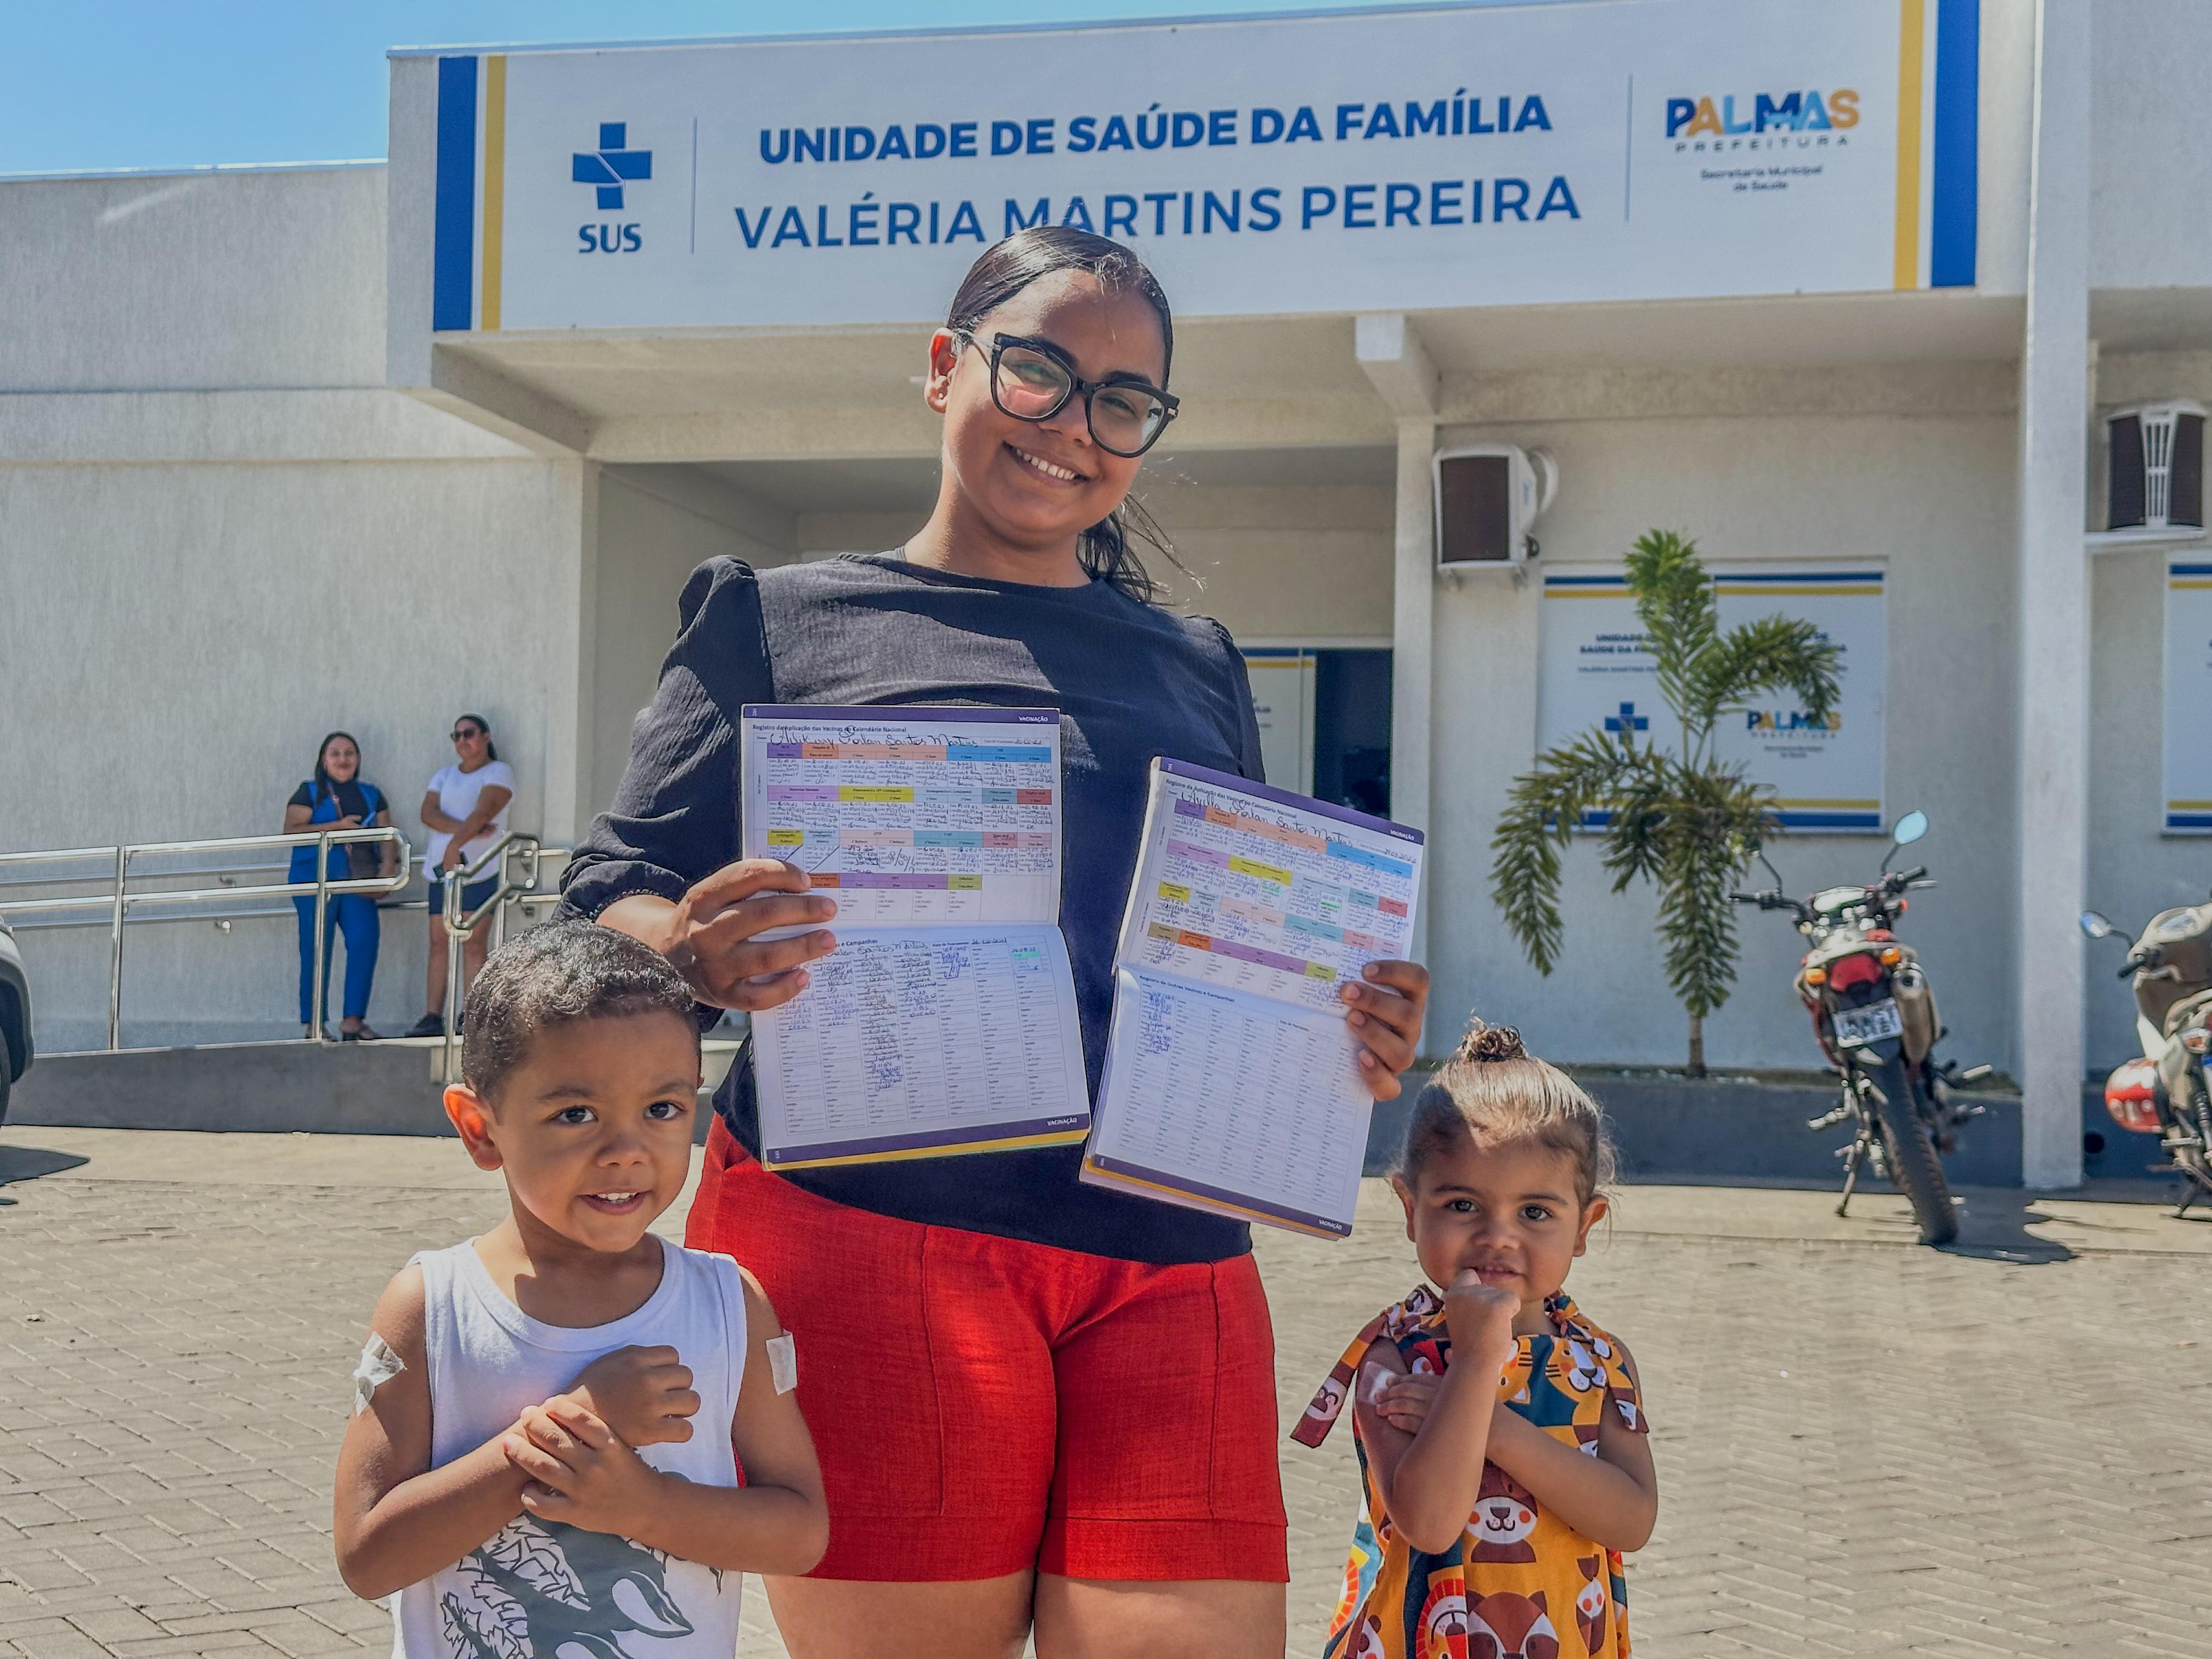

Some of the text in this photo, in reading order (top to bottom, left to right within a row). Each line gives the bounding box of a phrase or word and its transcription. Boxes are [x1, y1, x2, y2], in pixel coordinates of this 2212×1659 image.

[760, 87, 1552, 164] UNIDADE DE SAÚDE DA FAMÍLIA
[1666, 88, 1860, 138] PALMAS
[1675, 135, 1847, 153] PREFEITURA
[735, 176, 1581, 249] VALÉRIA MARTINS PEREIRA
[579, 223, 642, 253] SUS
[1047, 1117, 1078, 1126] VACINAÇÃO
